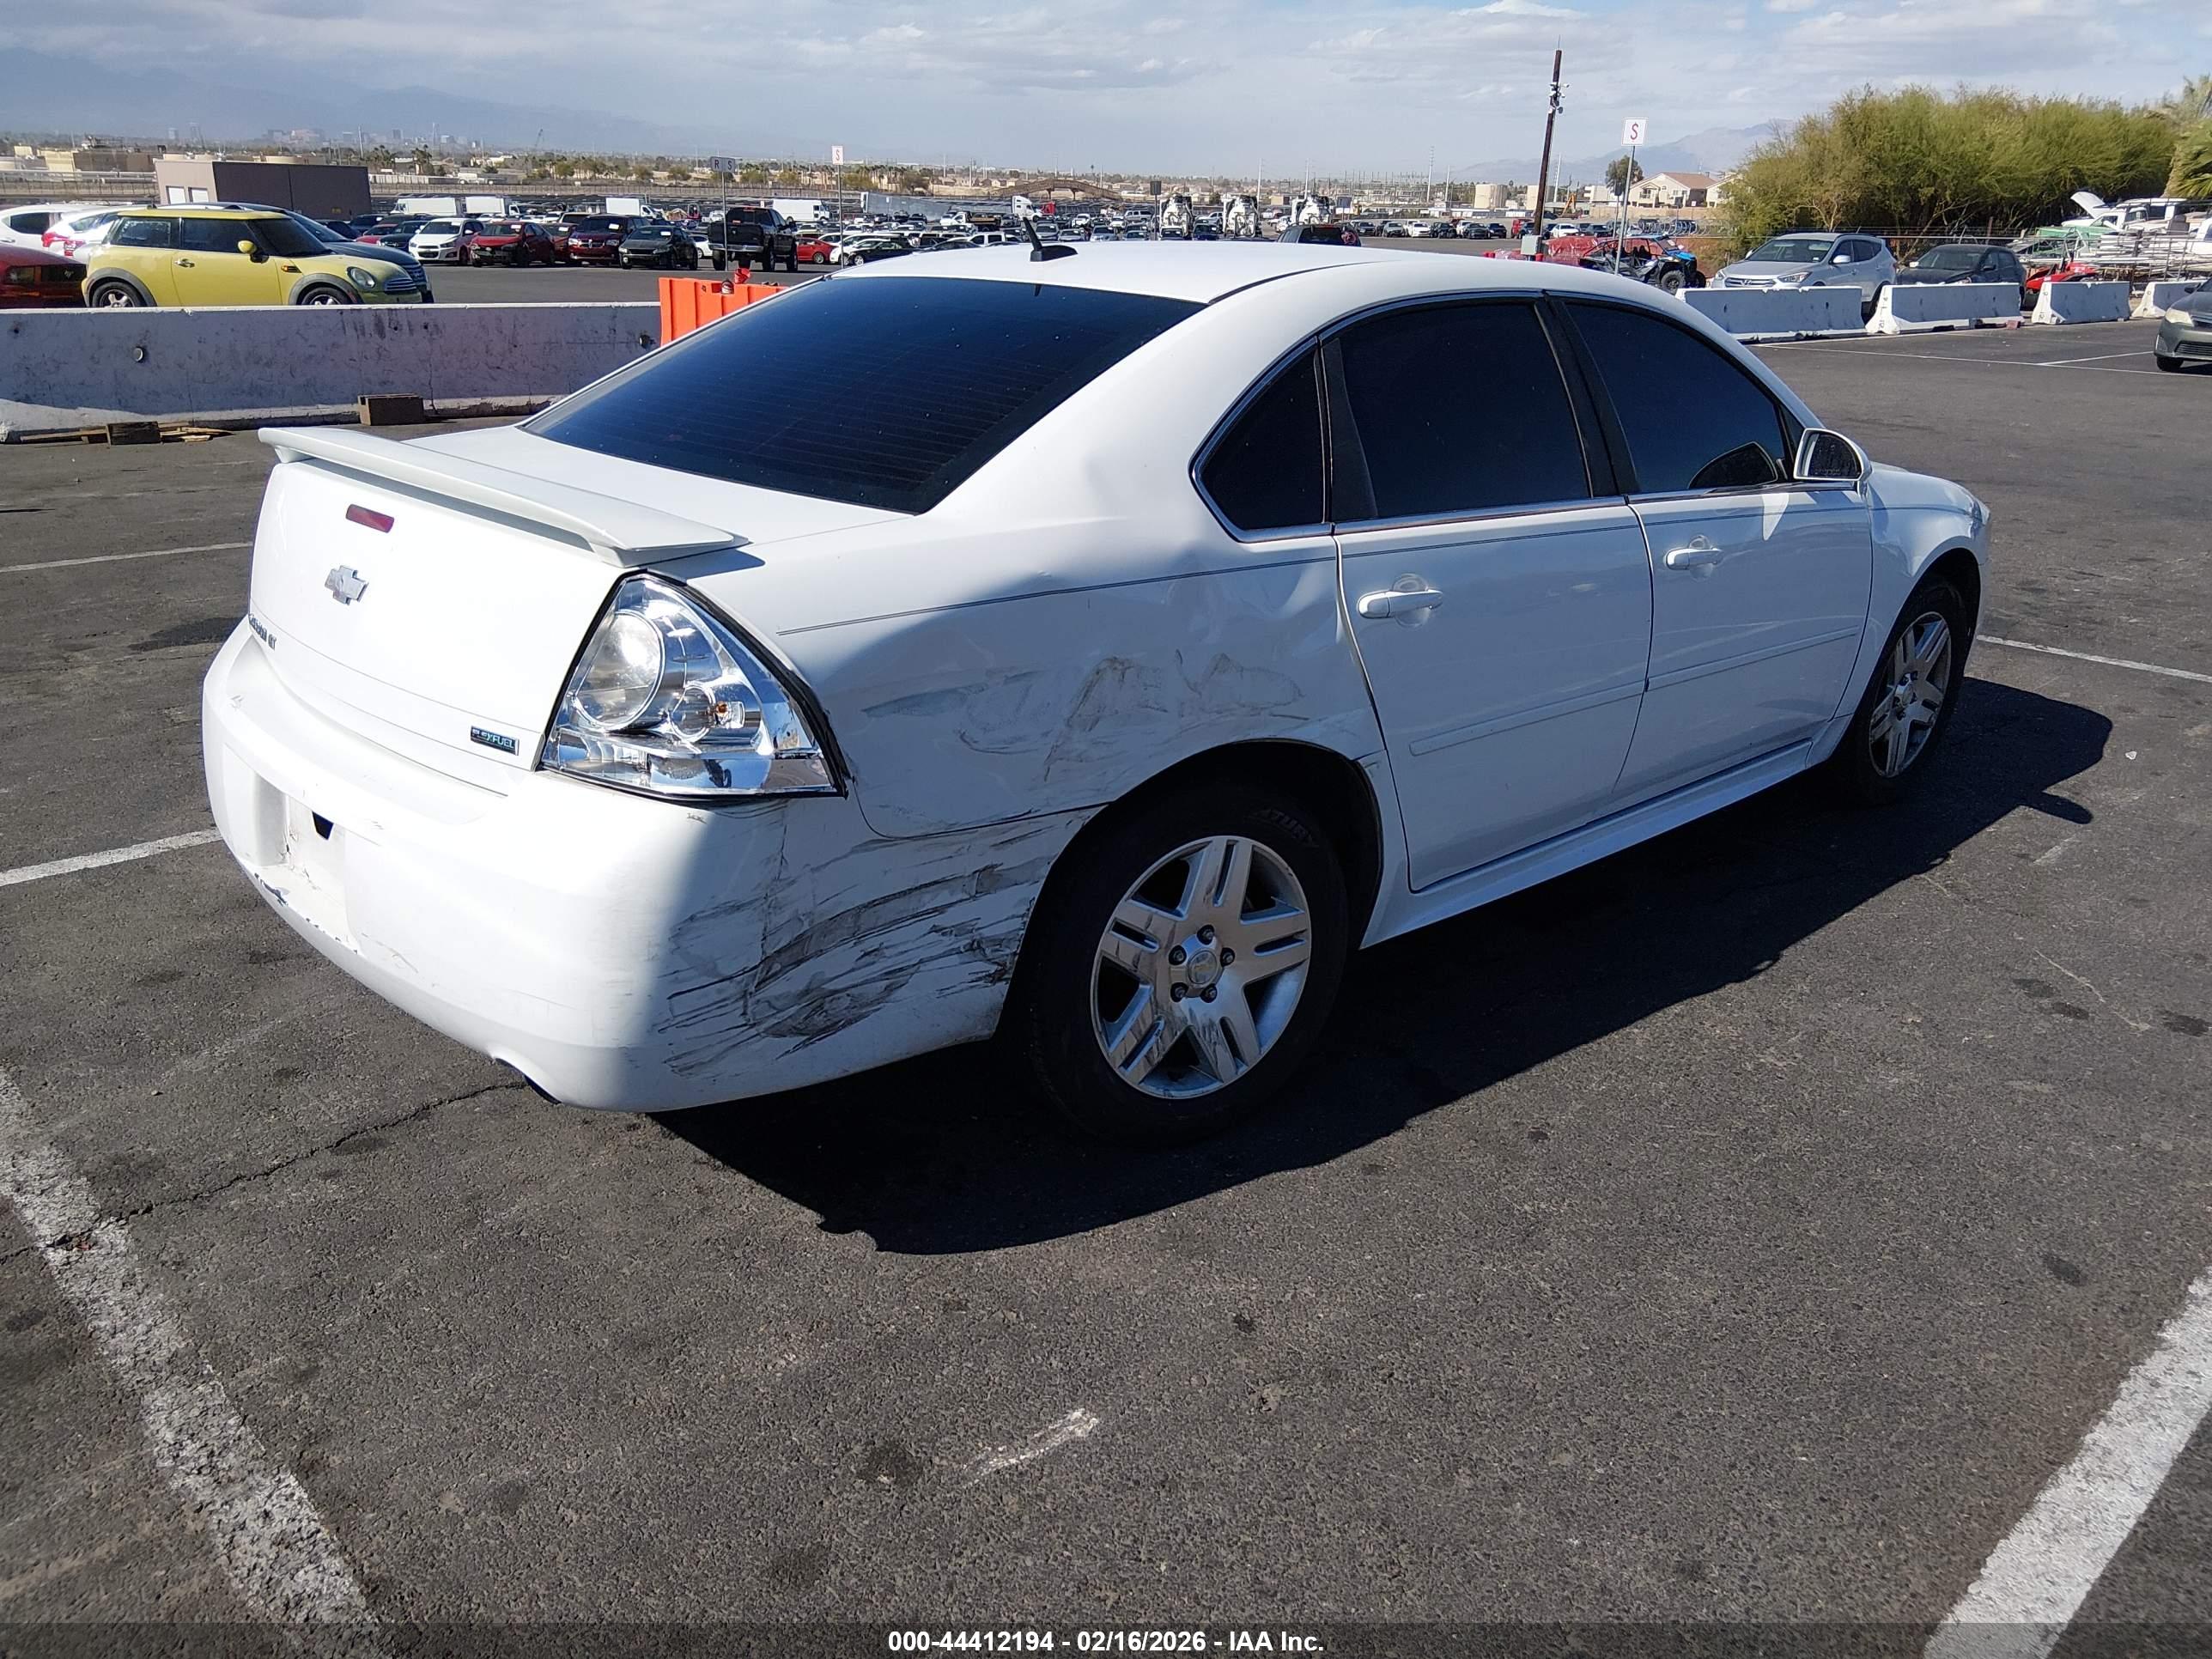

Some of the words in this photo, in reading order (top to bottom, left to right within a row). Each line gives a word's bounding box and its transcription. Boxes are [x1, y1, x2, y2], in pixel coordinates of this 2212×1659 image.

[836, 149, 840, 161] S
[714, 159, 720, 169] R
[727, 160, 732, 170] S
